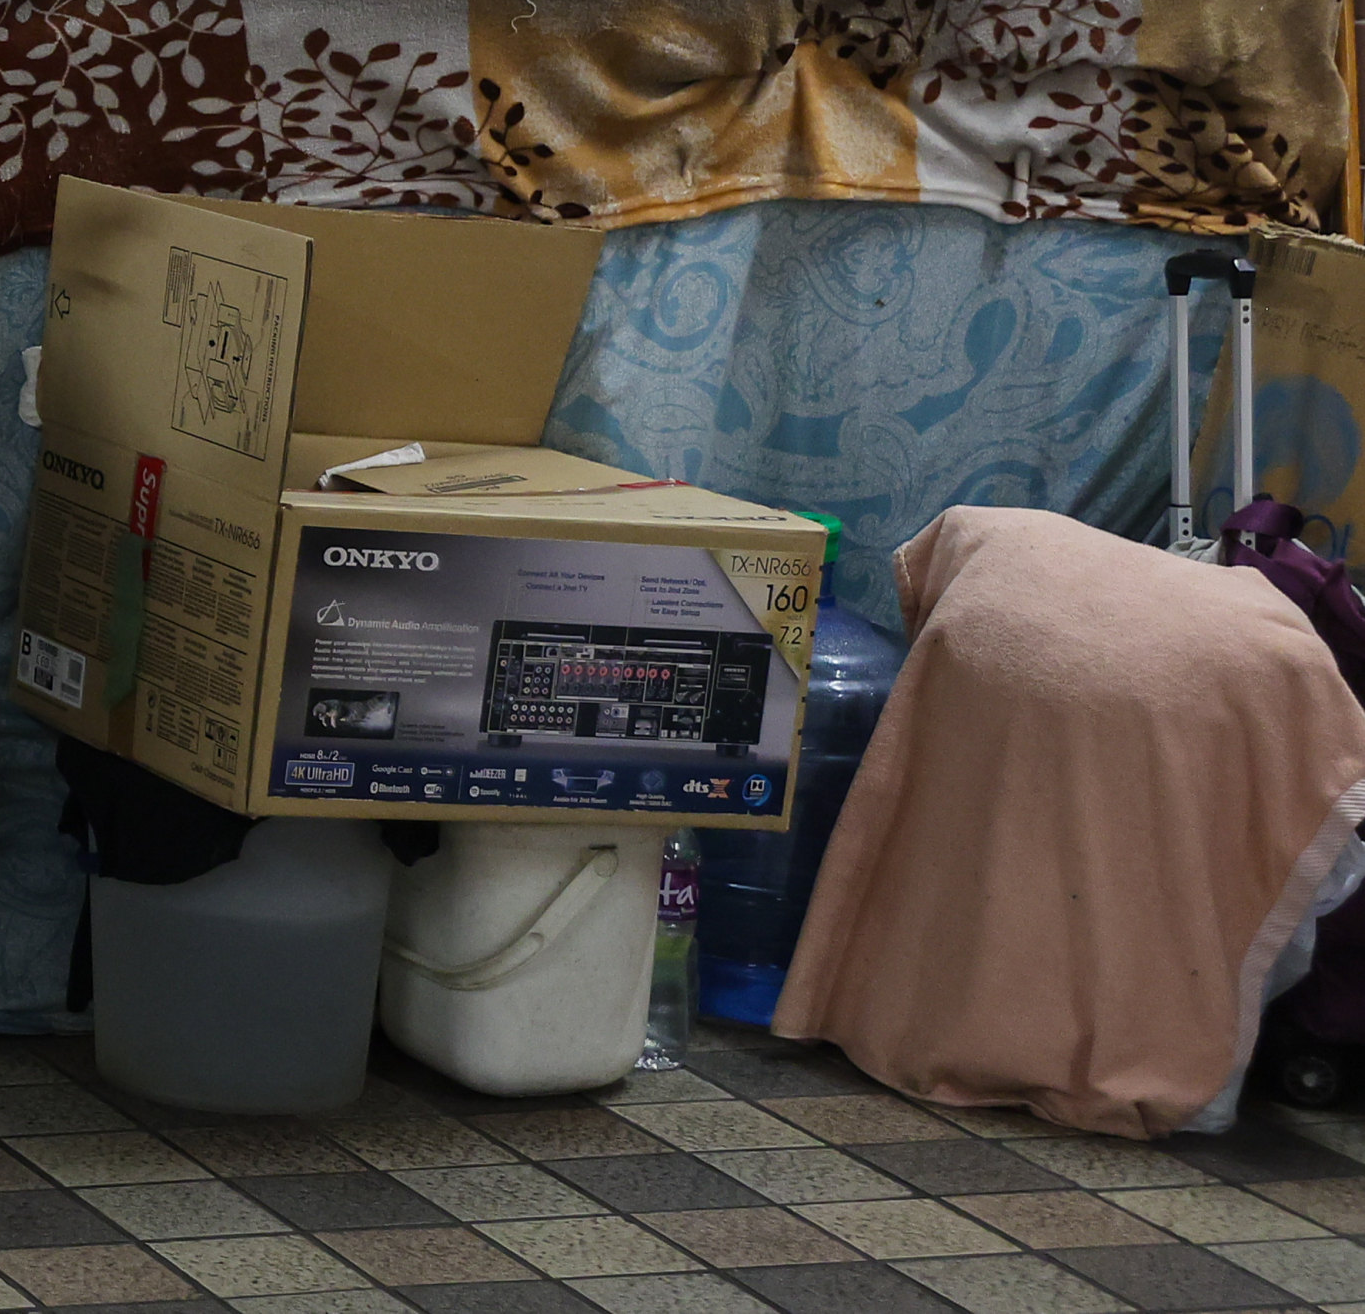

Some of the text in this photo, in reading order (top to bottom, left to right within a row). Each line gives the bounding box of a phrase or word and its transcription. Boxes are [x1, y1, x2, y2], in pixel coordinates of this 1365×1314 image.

[43, 450, 105, 491] ONKYO
[213, 517, 260, 550] TX-NR656
[323, 546, 440, 572] ONKYO
[731, 555, 812, 577] TX-NR656
[766, 584, 808, 612] 160
[347, 617, 479, 633] Dynamic Audio Amplification
[780, 626, 802, 644] 7.2
[291, 766, 306, 780] 4K
[372, 764, 397, 774] Google
